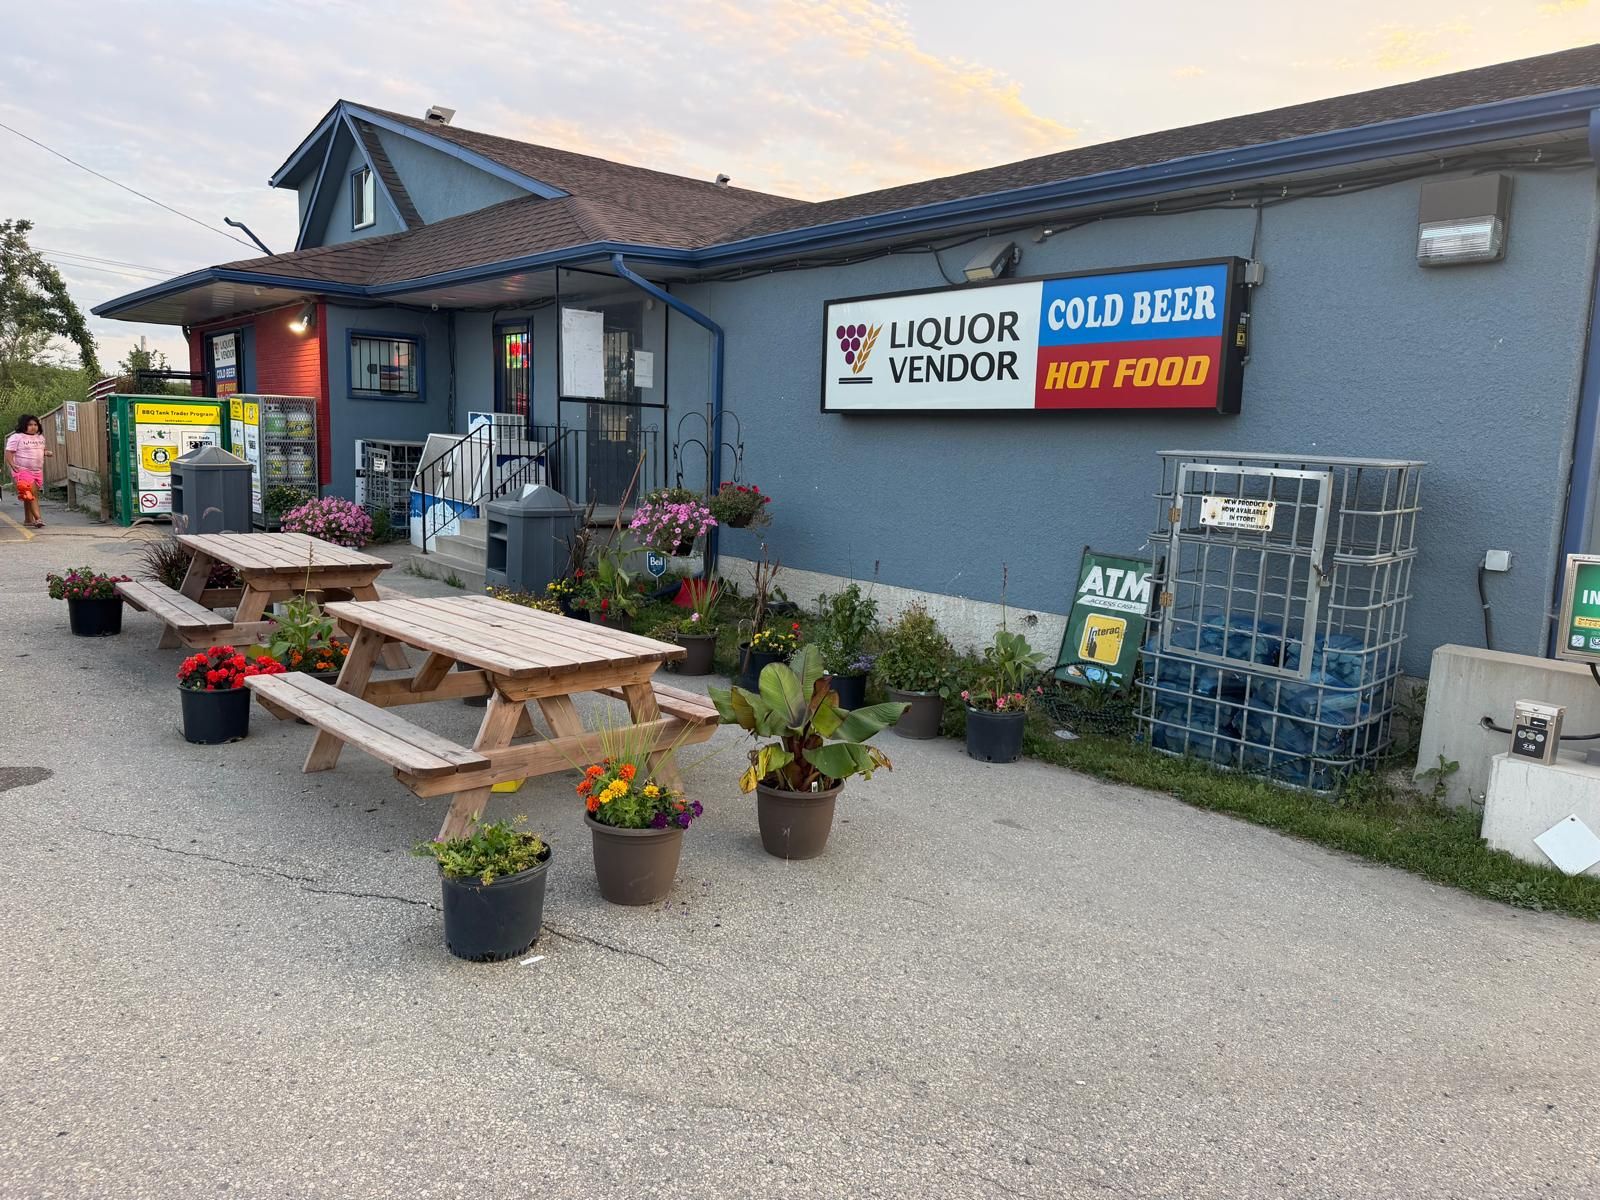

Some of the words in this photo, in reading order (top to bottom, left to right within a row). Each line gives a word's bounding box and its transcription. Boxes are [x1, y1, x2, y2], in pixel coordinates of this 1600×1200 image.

[1047, 293, 1125, 331] COLD
[1131, 284, 1217, 324] BEER
[890, 311, 1020, 350] LIQUOR
[220, 338, 235, 350] LIQUOR
[220, 349, 235, 360] VENDOR
[889, 350, 1020, 384] VENDOR
[1044, 359, 1110, 389] HOT
[1112, 355, 1211, 388] FOOD
[217, 369, 226, 379] COLD
[226, 368, 236, 378] BEER
[217, 383, 225, 393] HOT
[224, 382, 237, 392] FOOD
[1236, 508, 1268, 516] AVAILABLE
[1235, 515, 1257, 523] STORE!
[1079, 565, 1152, 603] ATM
[1089, 598, 1117, 608] ACCESS
[1089, 626, 1121, 640] Interac
